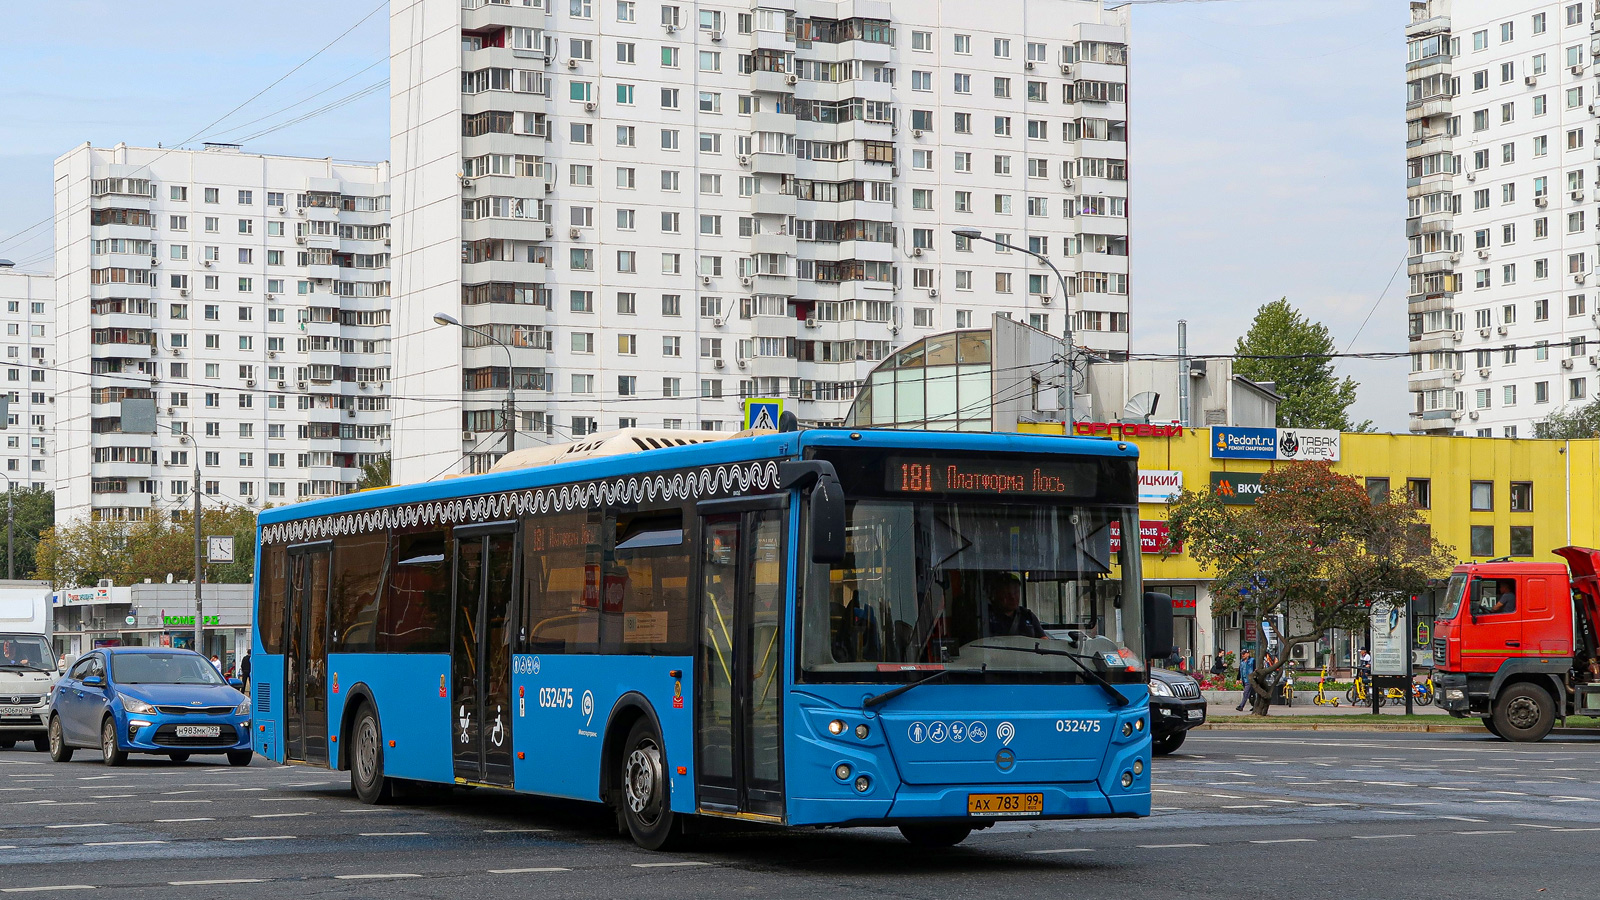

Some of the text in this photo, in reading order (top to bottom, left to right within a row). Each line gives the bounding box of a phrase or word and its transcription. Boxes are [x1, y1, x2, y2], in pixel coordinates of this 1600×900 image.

[1228, 434, 1274, 446] Pedant.ru
[1300, 436, 1337, 447] ТАБАК
[1302, 447, 1327, 456] VAPE
[901, 463, 1065, 493] 181 Платформа Лось
[1138, 472, 1178, 486] ИЦКИЙ
[164, 615, 220, 625] ЛОМБРД
[539, 687, 574, 709] 032475
[1056, 719, 1101, 733] 032475
[975, 795, 1039, 810] АХ 783 99
